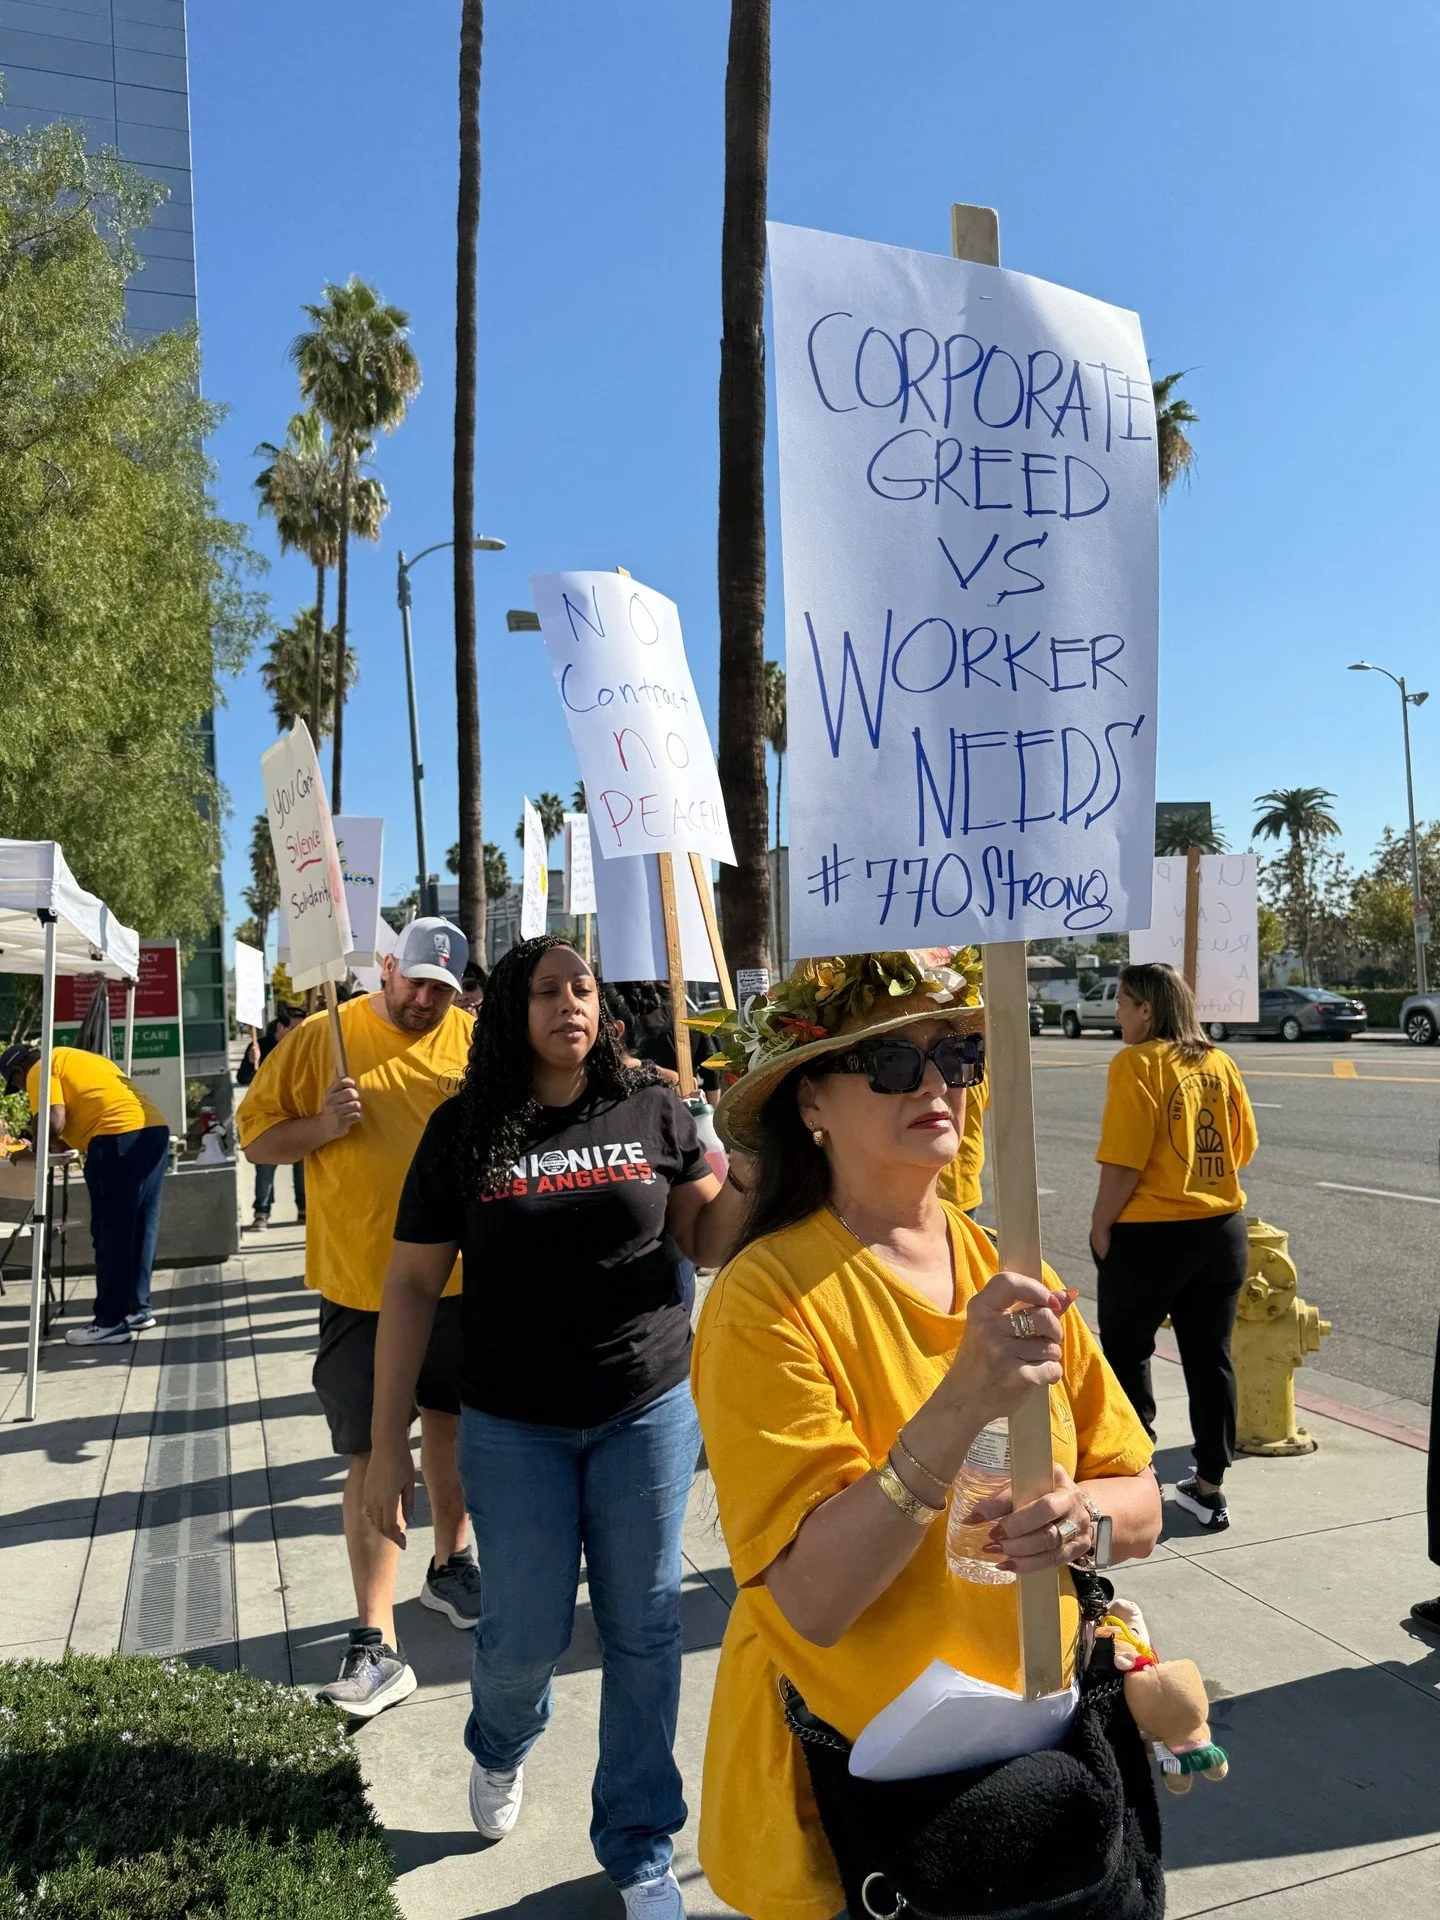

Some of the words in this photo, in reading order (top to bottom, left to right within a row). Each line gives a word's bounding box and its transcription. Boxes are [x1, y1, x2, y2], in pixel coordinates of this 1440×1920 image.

[808, 311, 1152, 452] CORPORATE
[867, 429, 1110, 521] GREED
[937, 532, 1049, 604] VS
[561, 663, 689, 714] Contract
[804, 609, 1128, 758] WORKER
[912, 714, 1145, 846] NEEDS
[285, 829, 321, 864] Silence
[291, 877, 333, 919] Solidarity
[142, 1031, 170, 1041] CARE
[536, 1162, 652, 1194] ANGELES
